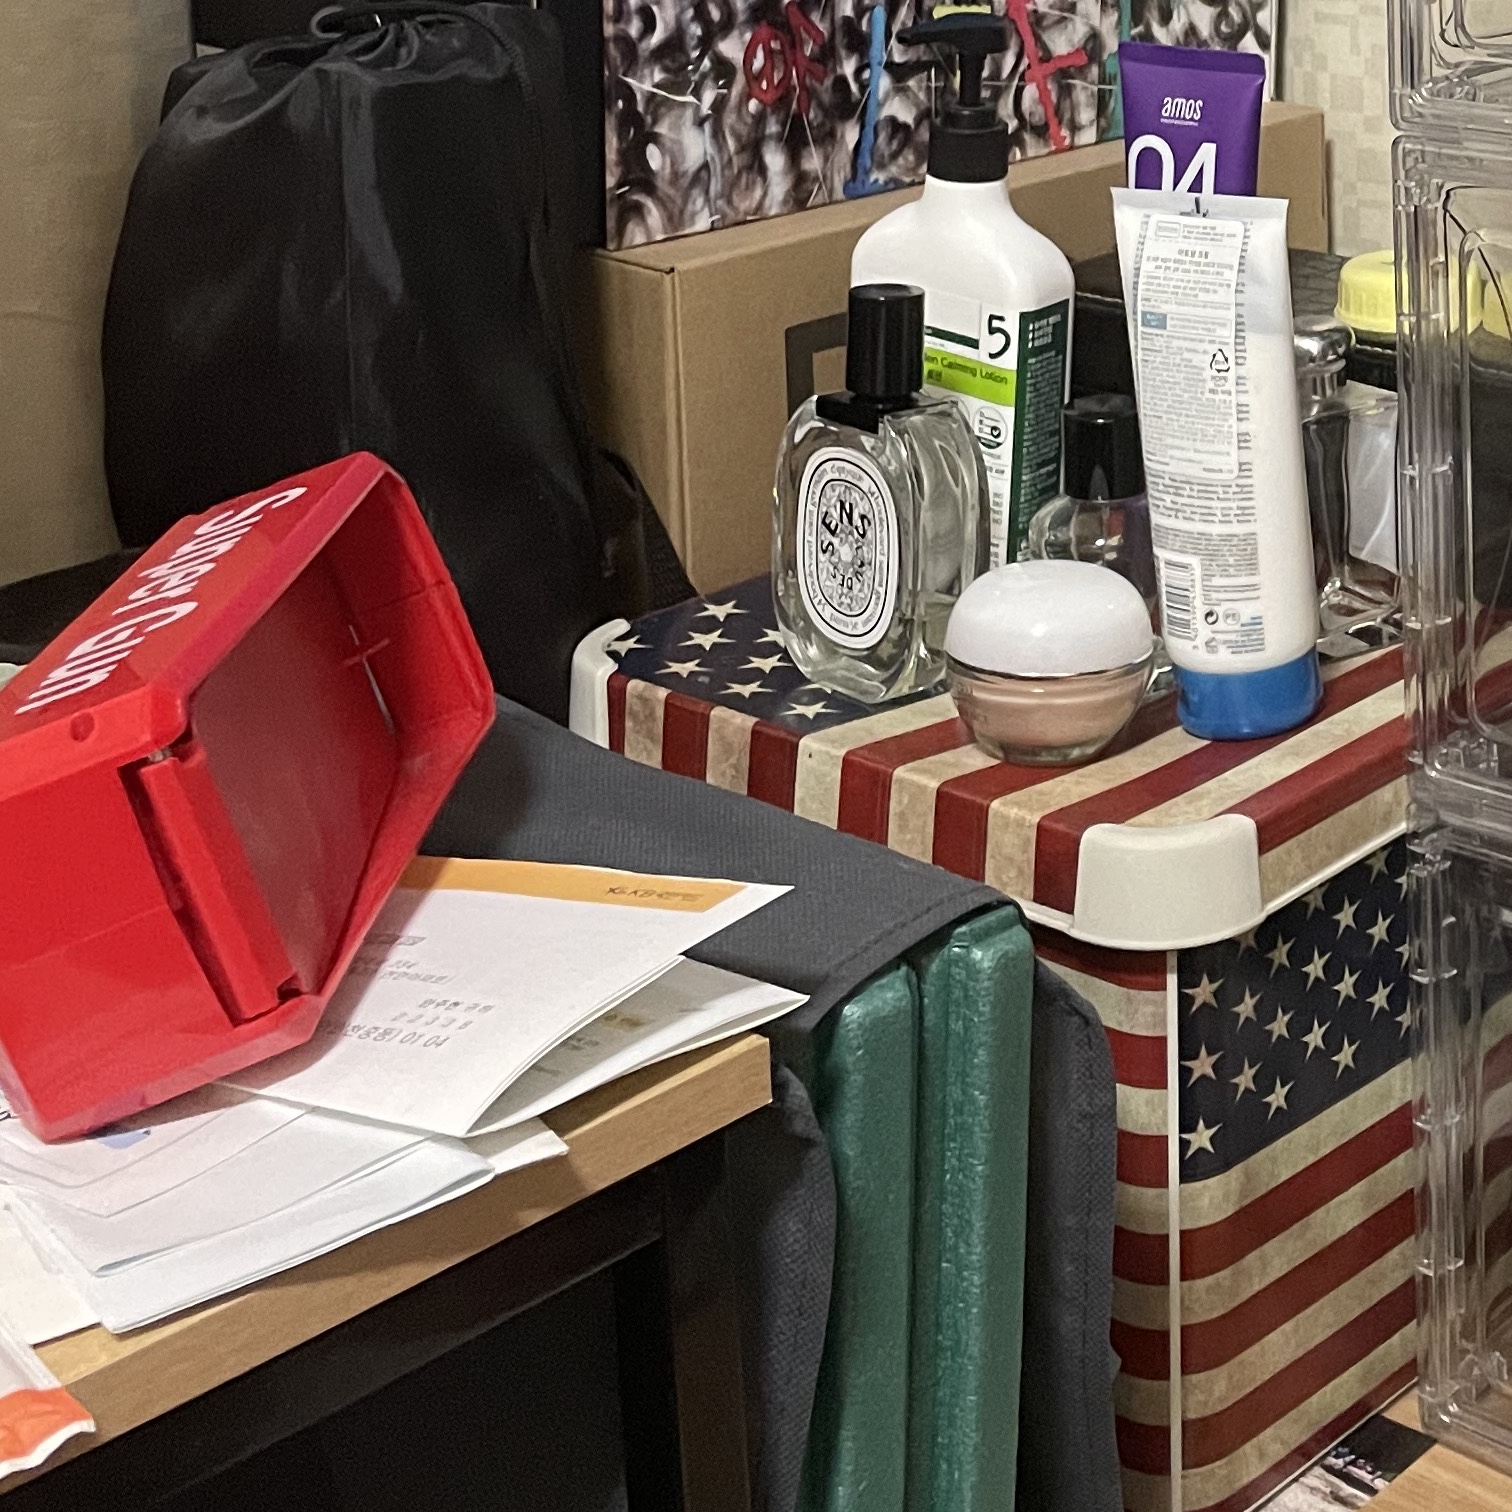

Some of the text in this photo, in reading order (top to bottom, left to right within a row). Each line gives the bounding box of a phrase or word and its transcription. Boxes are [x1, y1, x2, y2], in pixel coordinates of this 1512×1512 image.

[1161, 97, 1203, 120] amos
[988, 313, 1011, 360] 5
[980, 367, 1008, 386] Lotion
[821, 500, 871, 556] SENS
[15, 487, 307, 715] Super Gun
